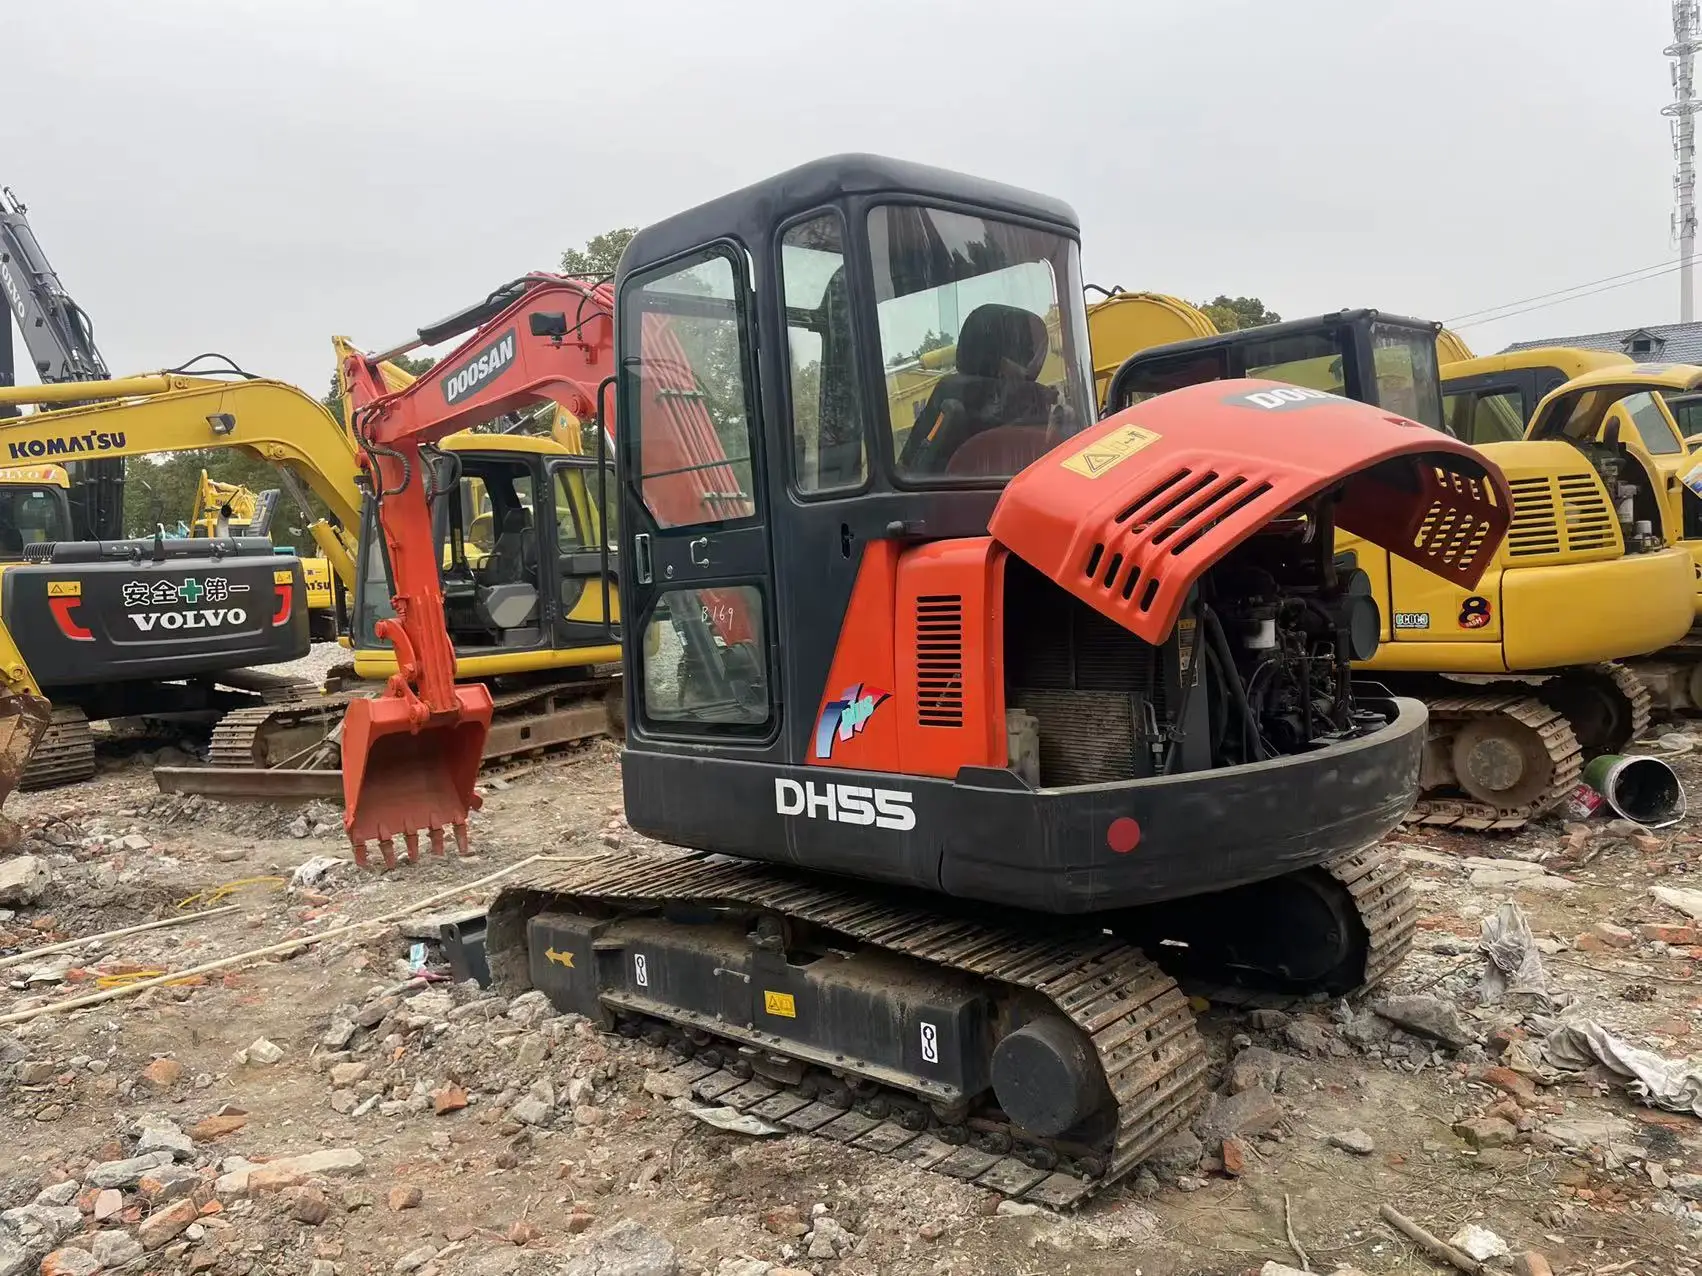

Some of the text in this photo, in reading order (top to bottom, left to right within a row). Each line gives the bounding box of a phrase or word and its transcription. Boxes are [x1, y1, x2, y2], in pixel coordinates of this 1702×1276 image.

[0, 252, 25, 318] OLVO
[447, 335, 513, 402] DOOSAN
[8, 430, 126, 459] KOMATSU
[127, 607, 247, 631] VOLVO
[701, 604, 734, 631] B169
[775, 777, 917, 831] DH55
